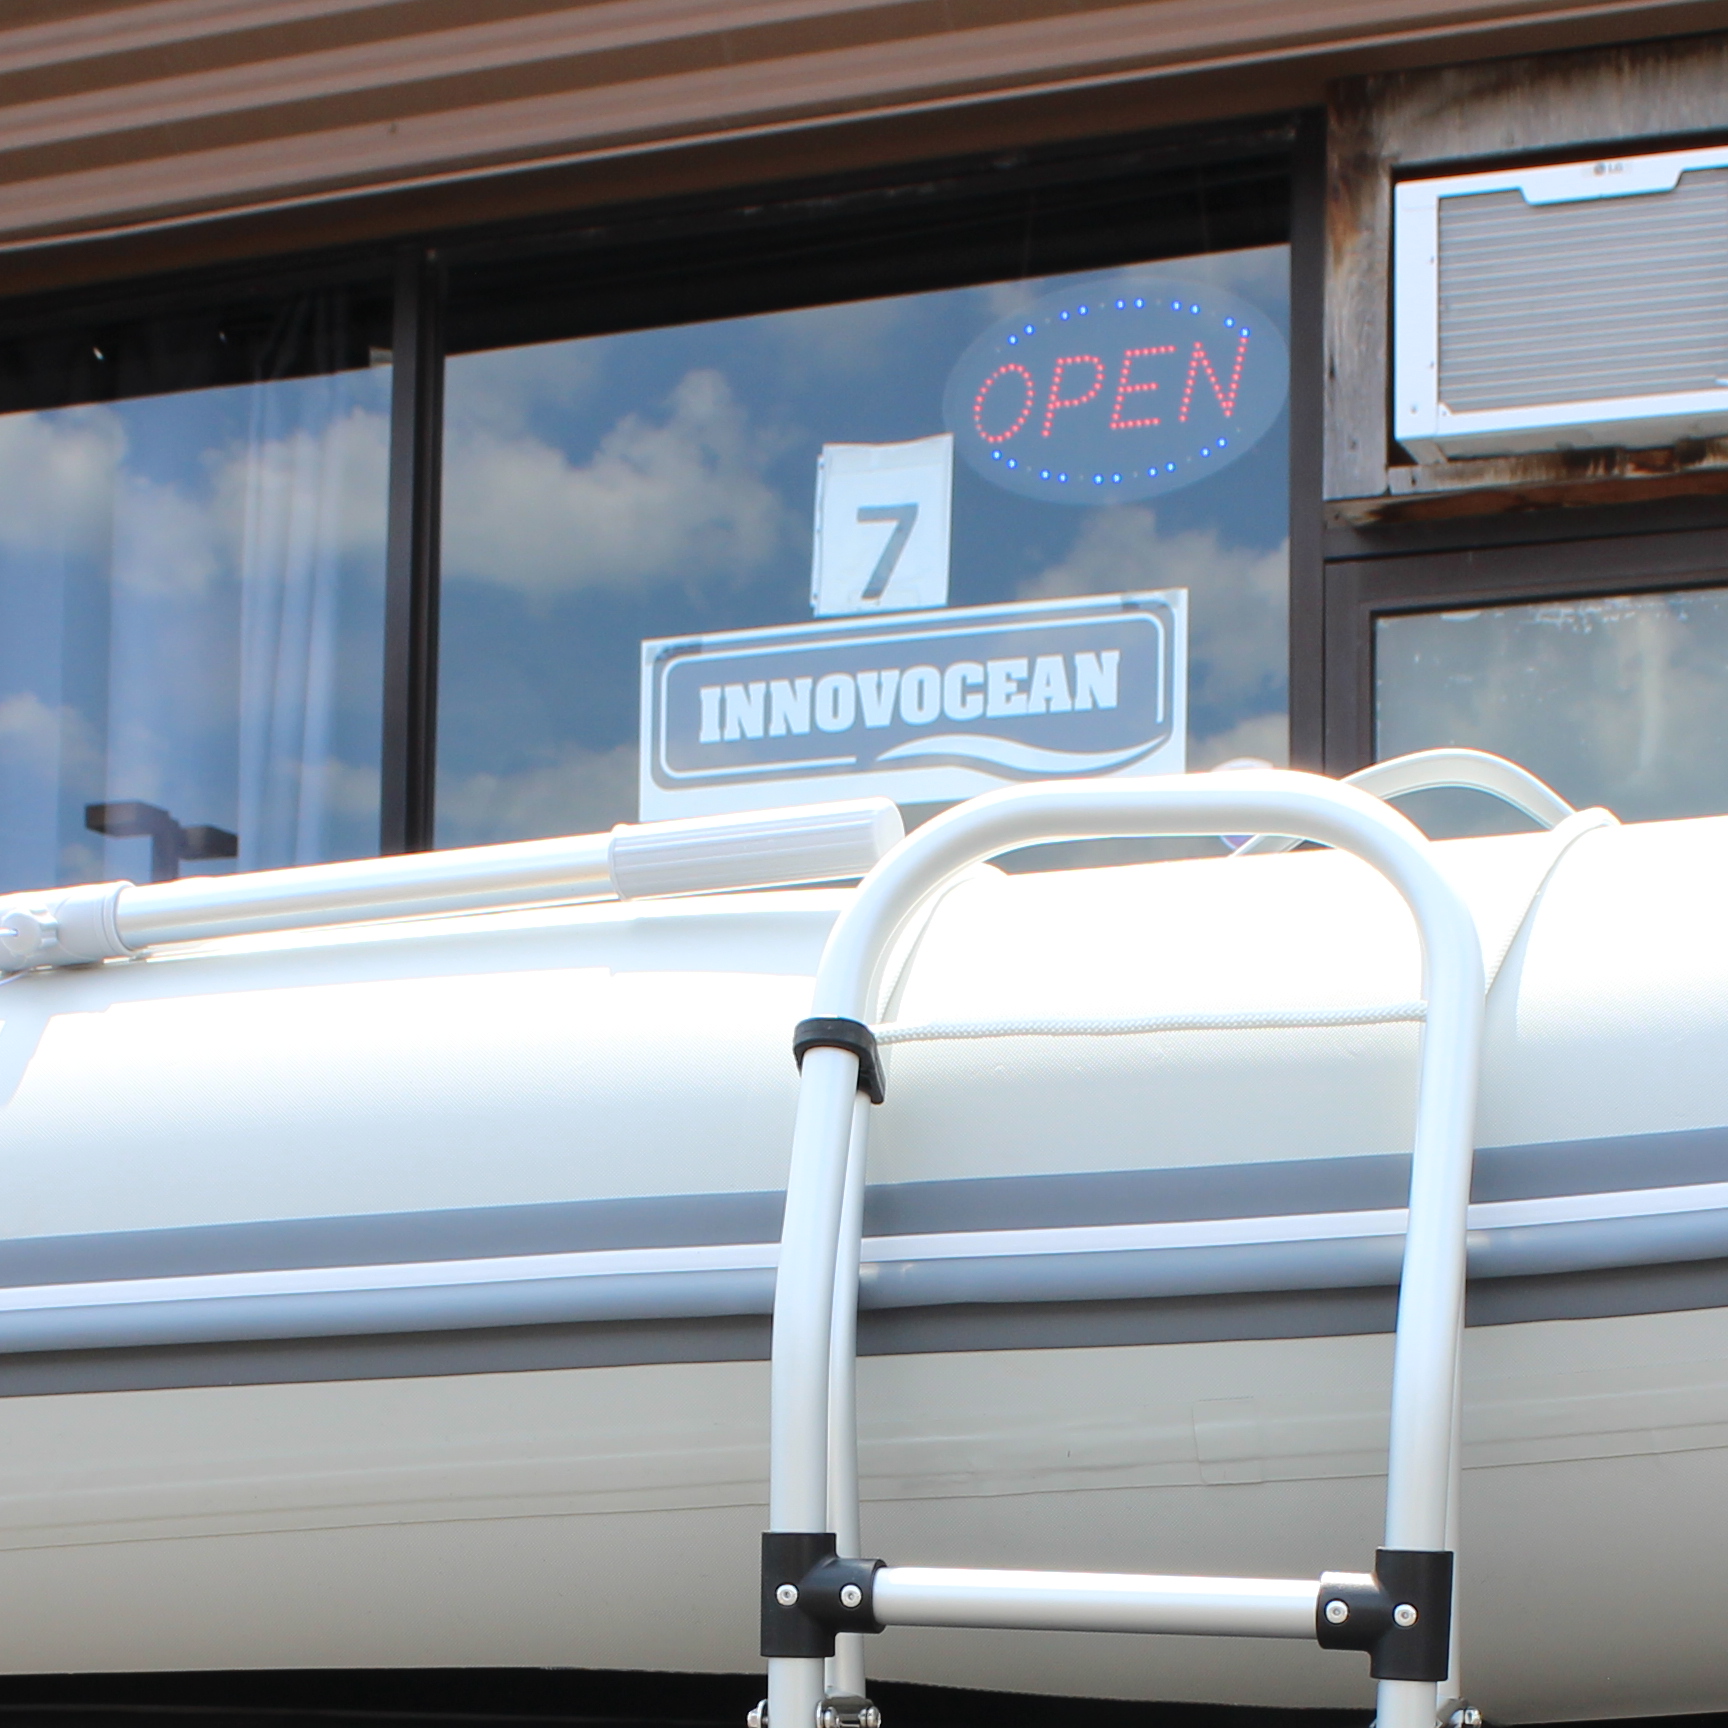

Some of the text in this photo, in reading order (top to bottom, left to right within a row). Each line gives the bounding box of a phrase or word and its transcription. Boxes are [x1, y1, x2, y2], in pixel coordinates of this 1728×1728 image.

[974, 336, 1250, 445] OPEN
[856, 502, 920, 601] 7
[699, 649, 1121, 744] INNOVOCEAN
